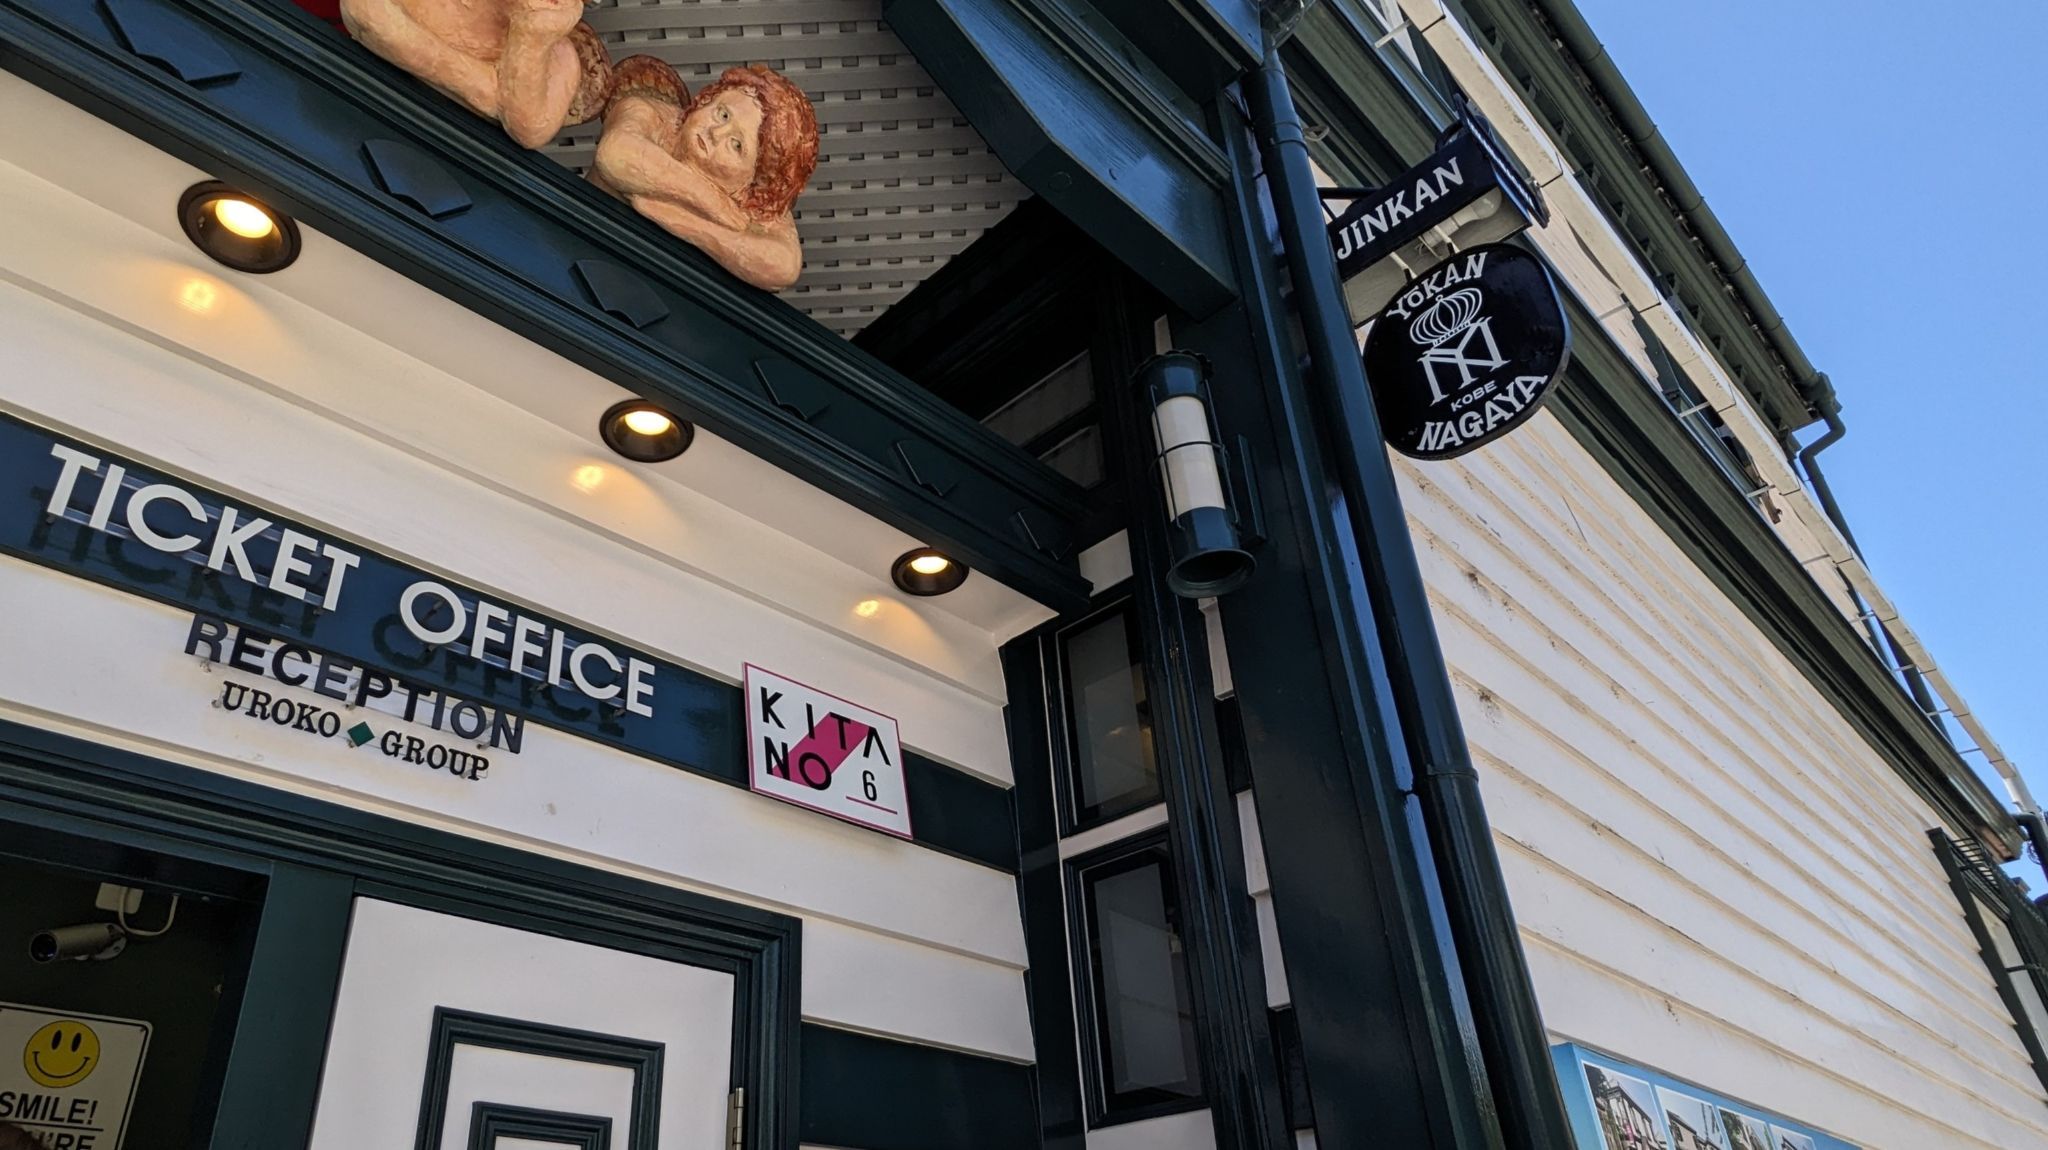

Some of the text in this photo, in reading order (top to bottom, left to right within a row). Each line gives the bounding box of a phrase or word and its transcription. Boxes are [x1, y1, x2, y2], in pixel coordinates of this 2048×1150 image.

[1416, 375, 1549, 451] NAGAYA
[1450, 380, 1498, 412] KOBE
[46, 443, 656, 719] TICKET OFFICE
[184, 614, 525, 755] RECEPTION
[221, 680, 490, 782] UROKO GROUP
[764, 735, 878, 802] NO 6
[0, 1091, 98, 1125] SMILE!
